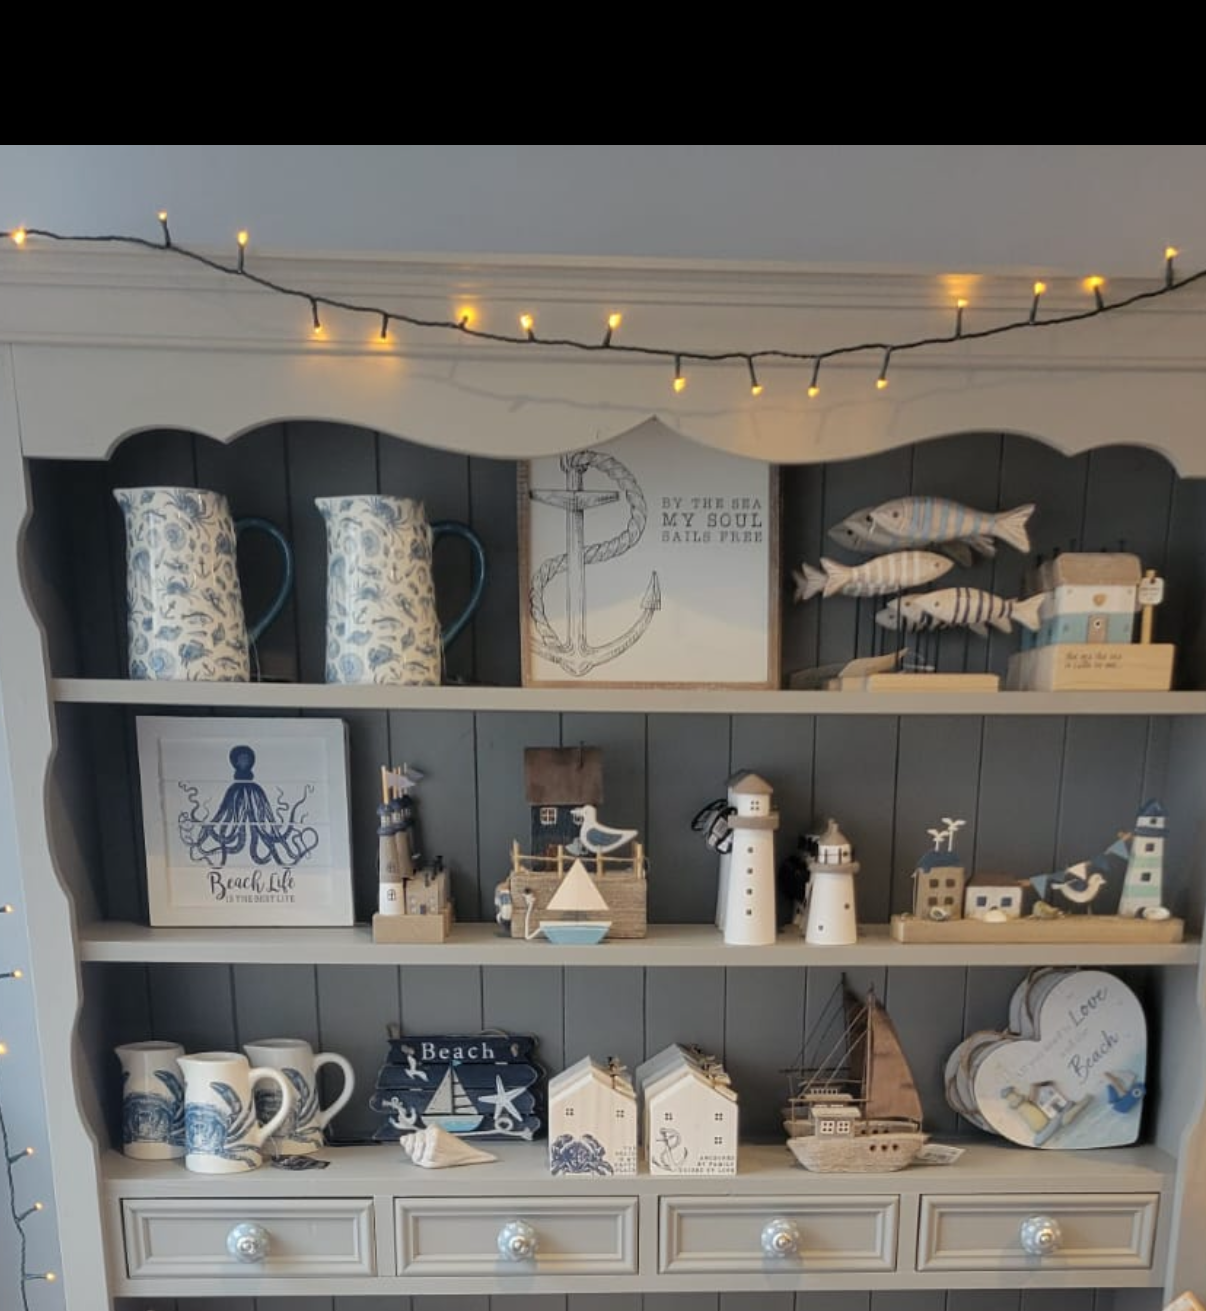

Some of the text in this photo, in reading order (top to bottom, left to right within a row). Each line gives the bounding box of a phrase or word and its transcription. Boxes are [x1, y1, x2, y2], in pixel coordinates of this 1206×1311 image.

[662, 497, 761, 509] BY THE SEA
[662, 512, 762, 527] MY SOUL
[662, 530, 762, 542] SAILS FREE
[207, 868, 296, 900] Beach Life
[1068, 987, 1108, 1027] Love
[421, 1041, 495, 1060] Beach
[1067, 1030, 1120, 1084] Beach
